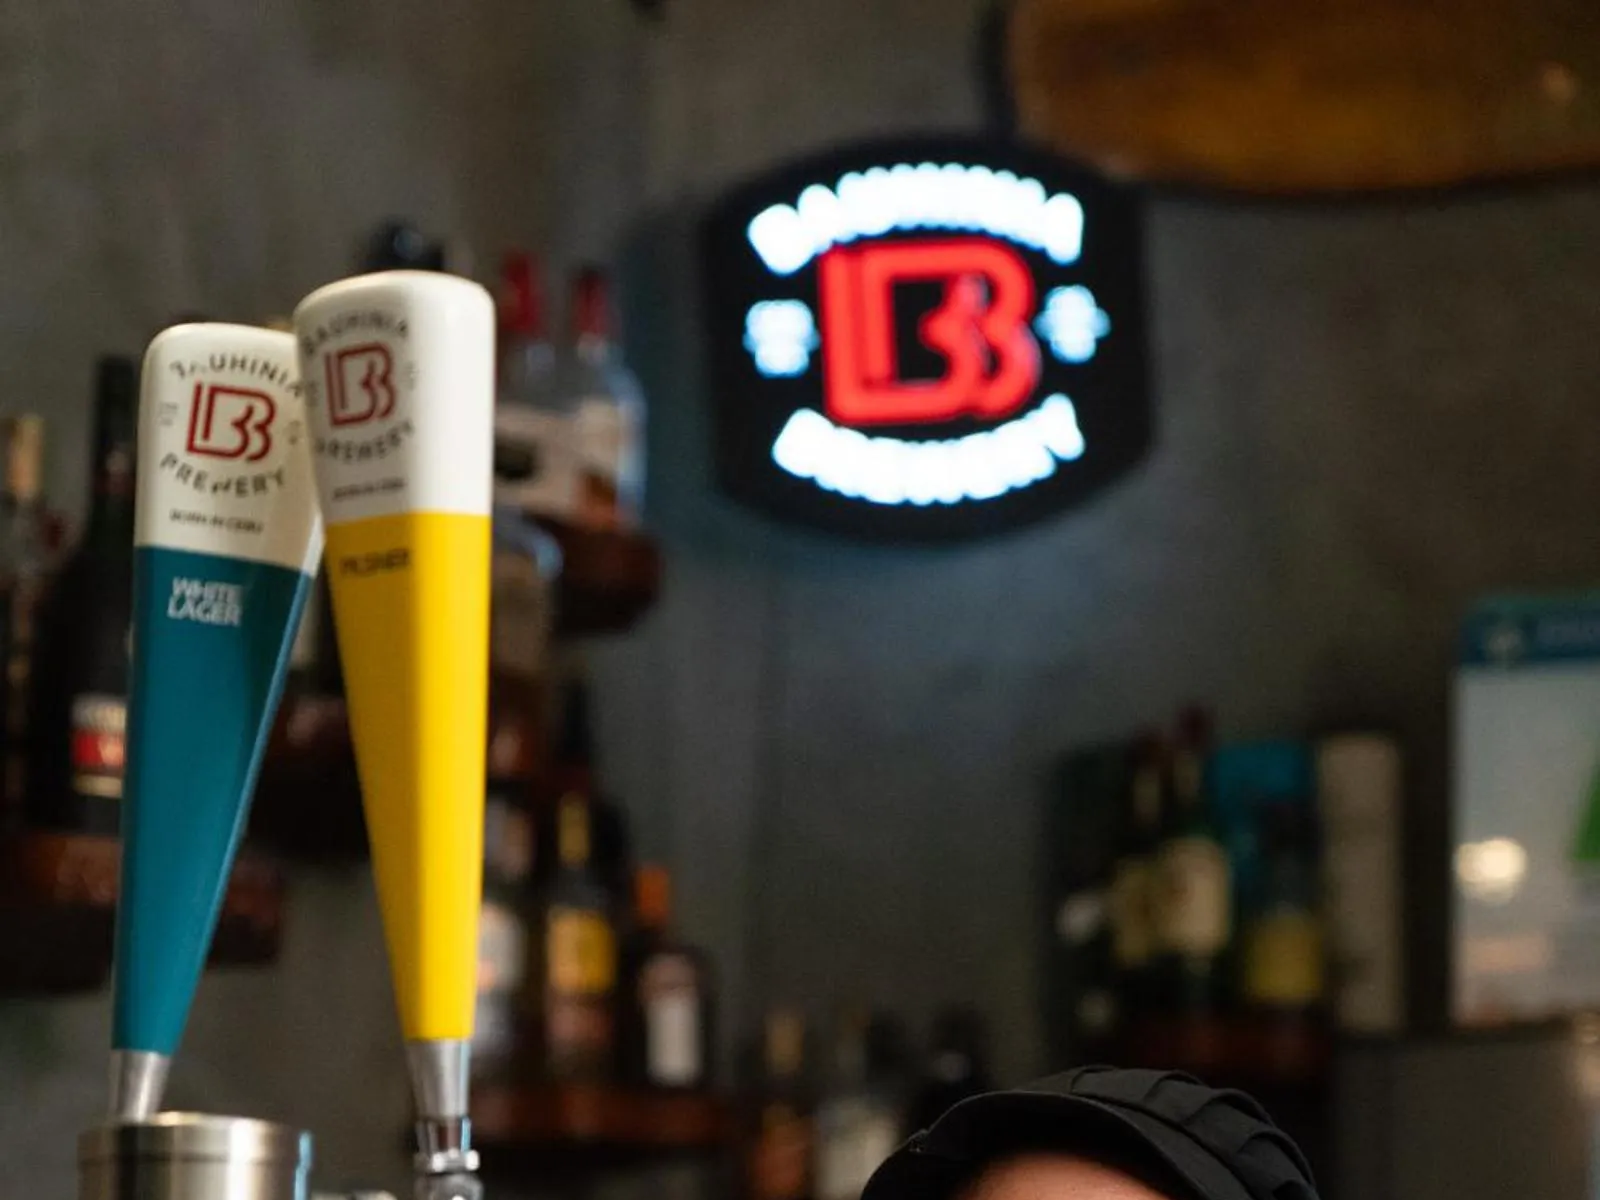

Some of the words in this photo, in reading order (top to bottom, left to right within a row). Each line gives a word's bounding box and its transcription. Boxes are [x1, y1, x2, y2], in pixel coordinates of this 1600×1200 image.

[323, 340, 397, 429] B
[185, 379, 277, 463] B
[167, 595, 242, 627] LAGER
[172, 576, 242, 603] WHITE
